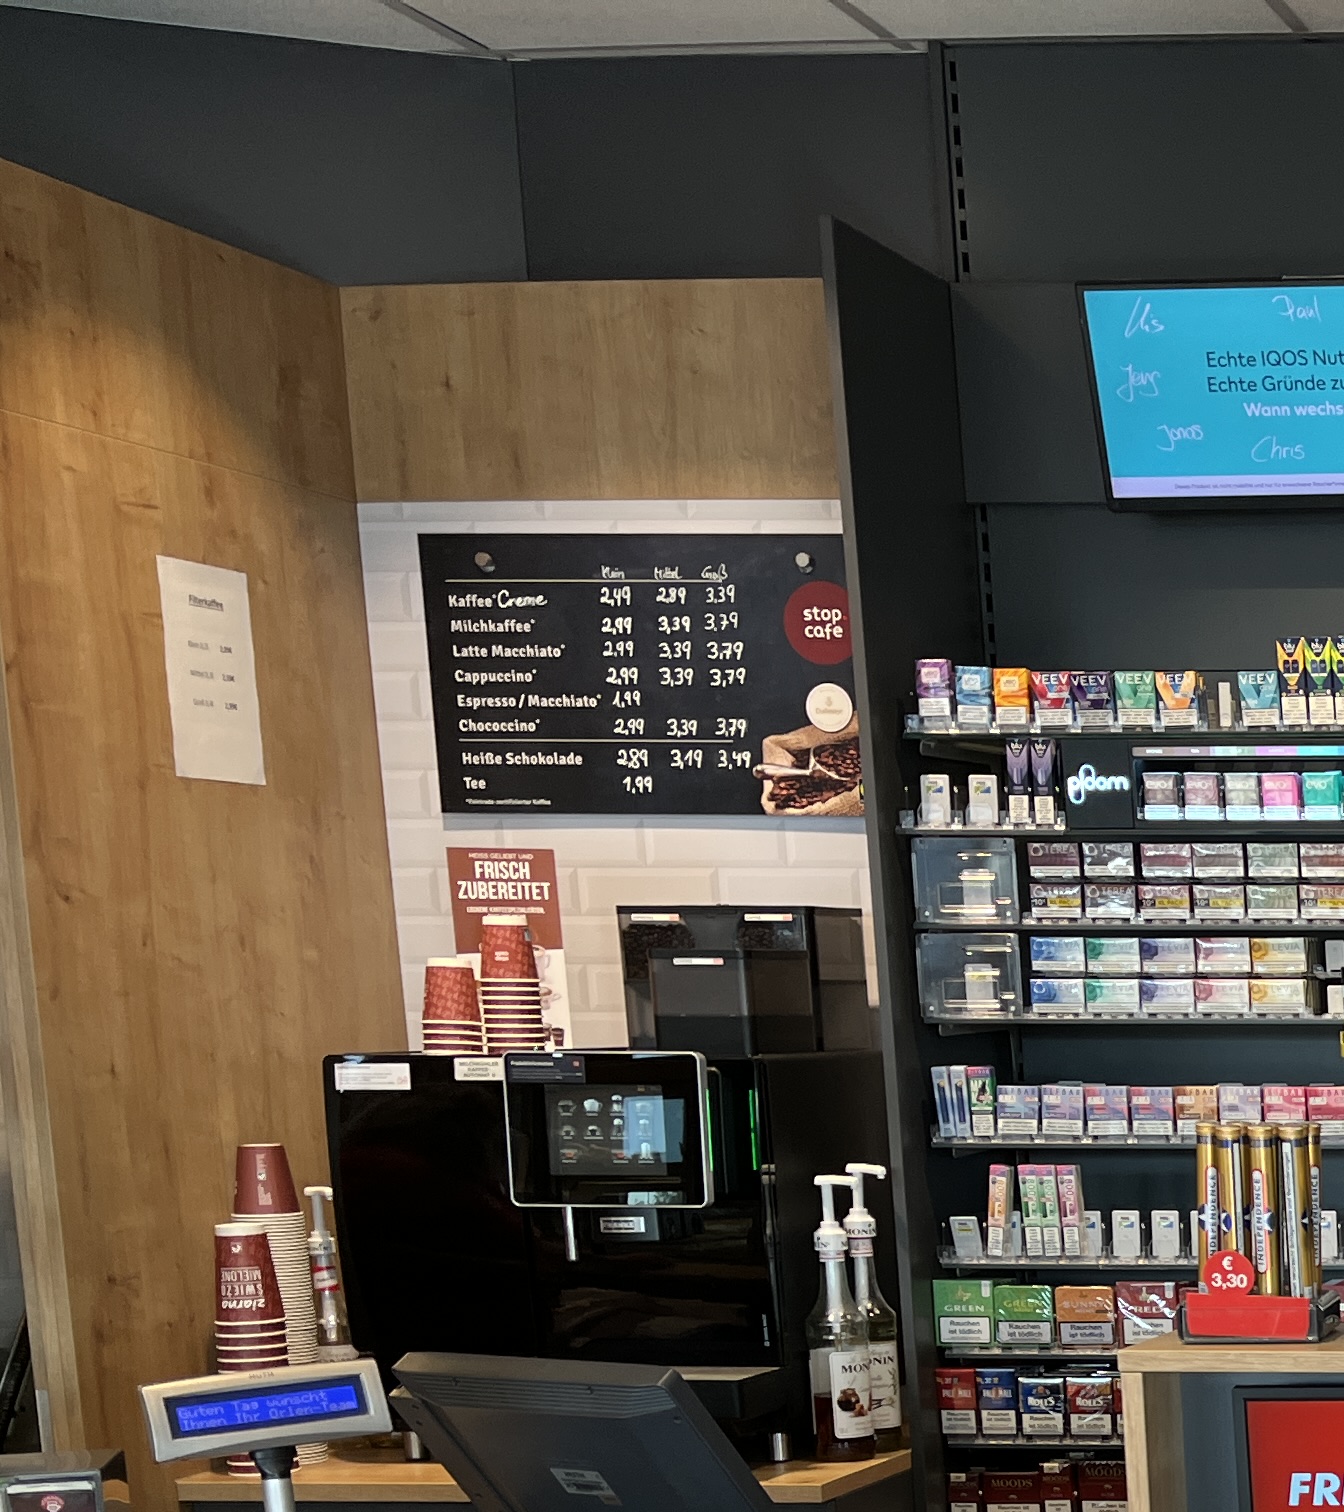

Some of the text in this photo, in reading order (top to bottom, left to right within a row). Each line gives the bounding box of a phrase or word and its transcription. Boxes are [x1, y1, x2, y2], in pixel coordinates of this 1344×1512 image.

[1206, 351, 1257, 368] Echte
[1261, 350, 1308, 368] IQOS
[1208, 376, 1258, 393] Echte
[1263, 374, 1326, 392] Gründe
[1243, 402, 1291, 417] Wann
[1157, 424, 1204, 451] Jonas
[1251, 436, 1305, 462] Chris
[497, 590, 548, 608] Creme
[602, 616, 632, 635] 2,99
[658, 615, 690, 633] 3,39
[804, 623, 843, 640] cafe
[452, 645, 489, 658] Latte
[457, 694, 515, 709] Espresso
[462, 751, 583, 766] Heiße Schokolade
[463, 777, 486, 789] Tee
[474, 861, 530, 880] FRISCH
[457, 881, 550, 901] ZUBEREITET
[1222, 1256, 1234, 1271] €
[1211, 1273, 1248, 1290] 3,30
